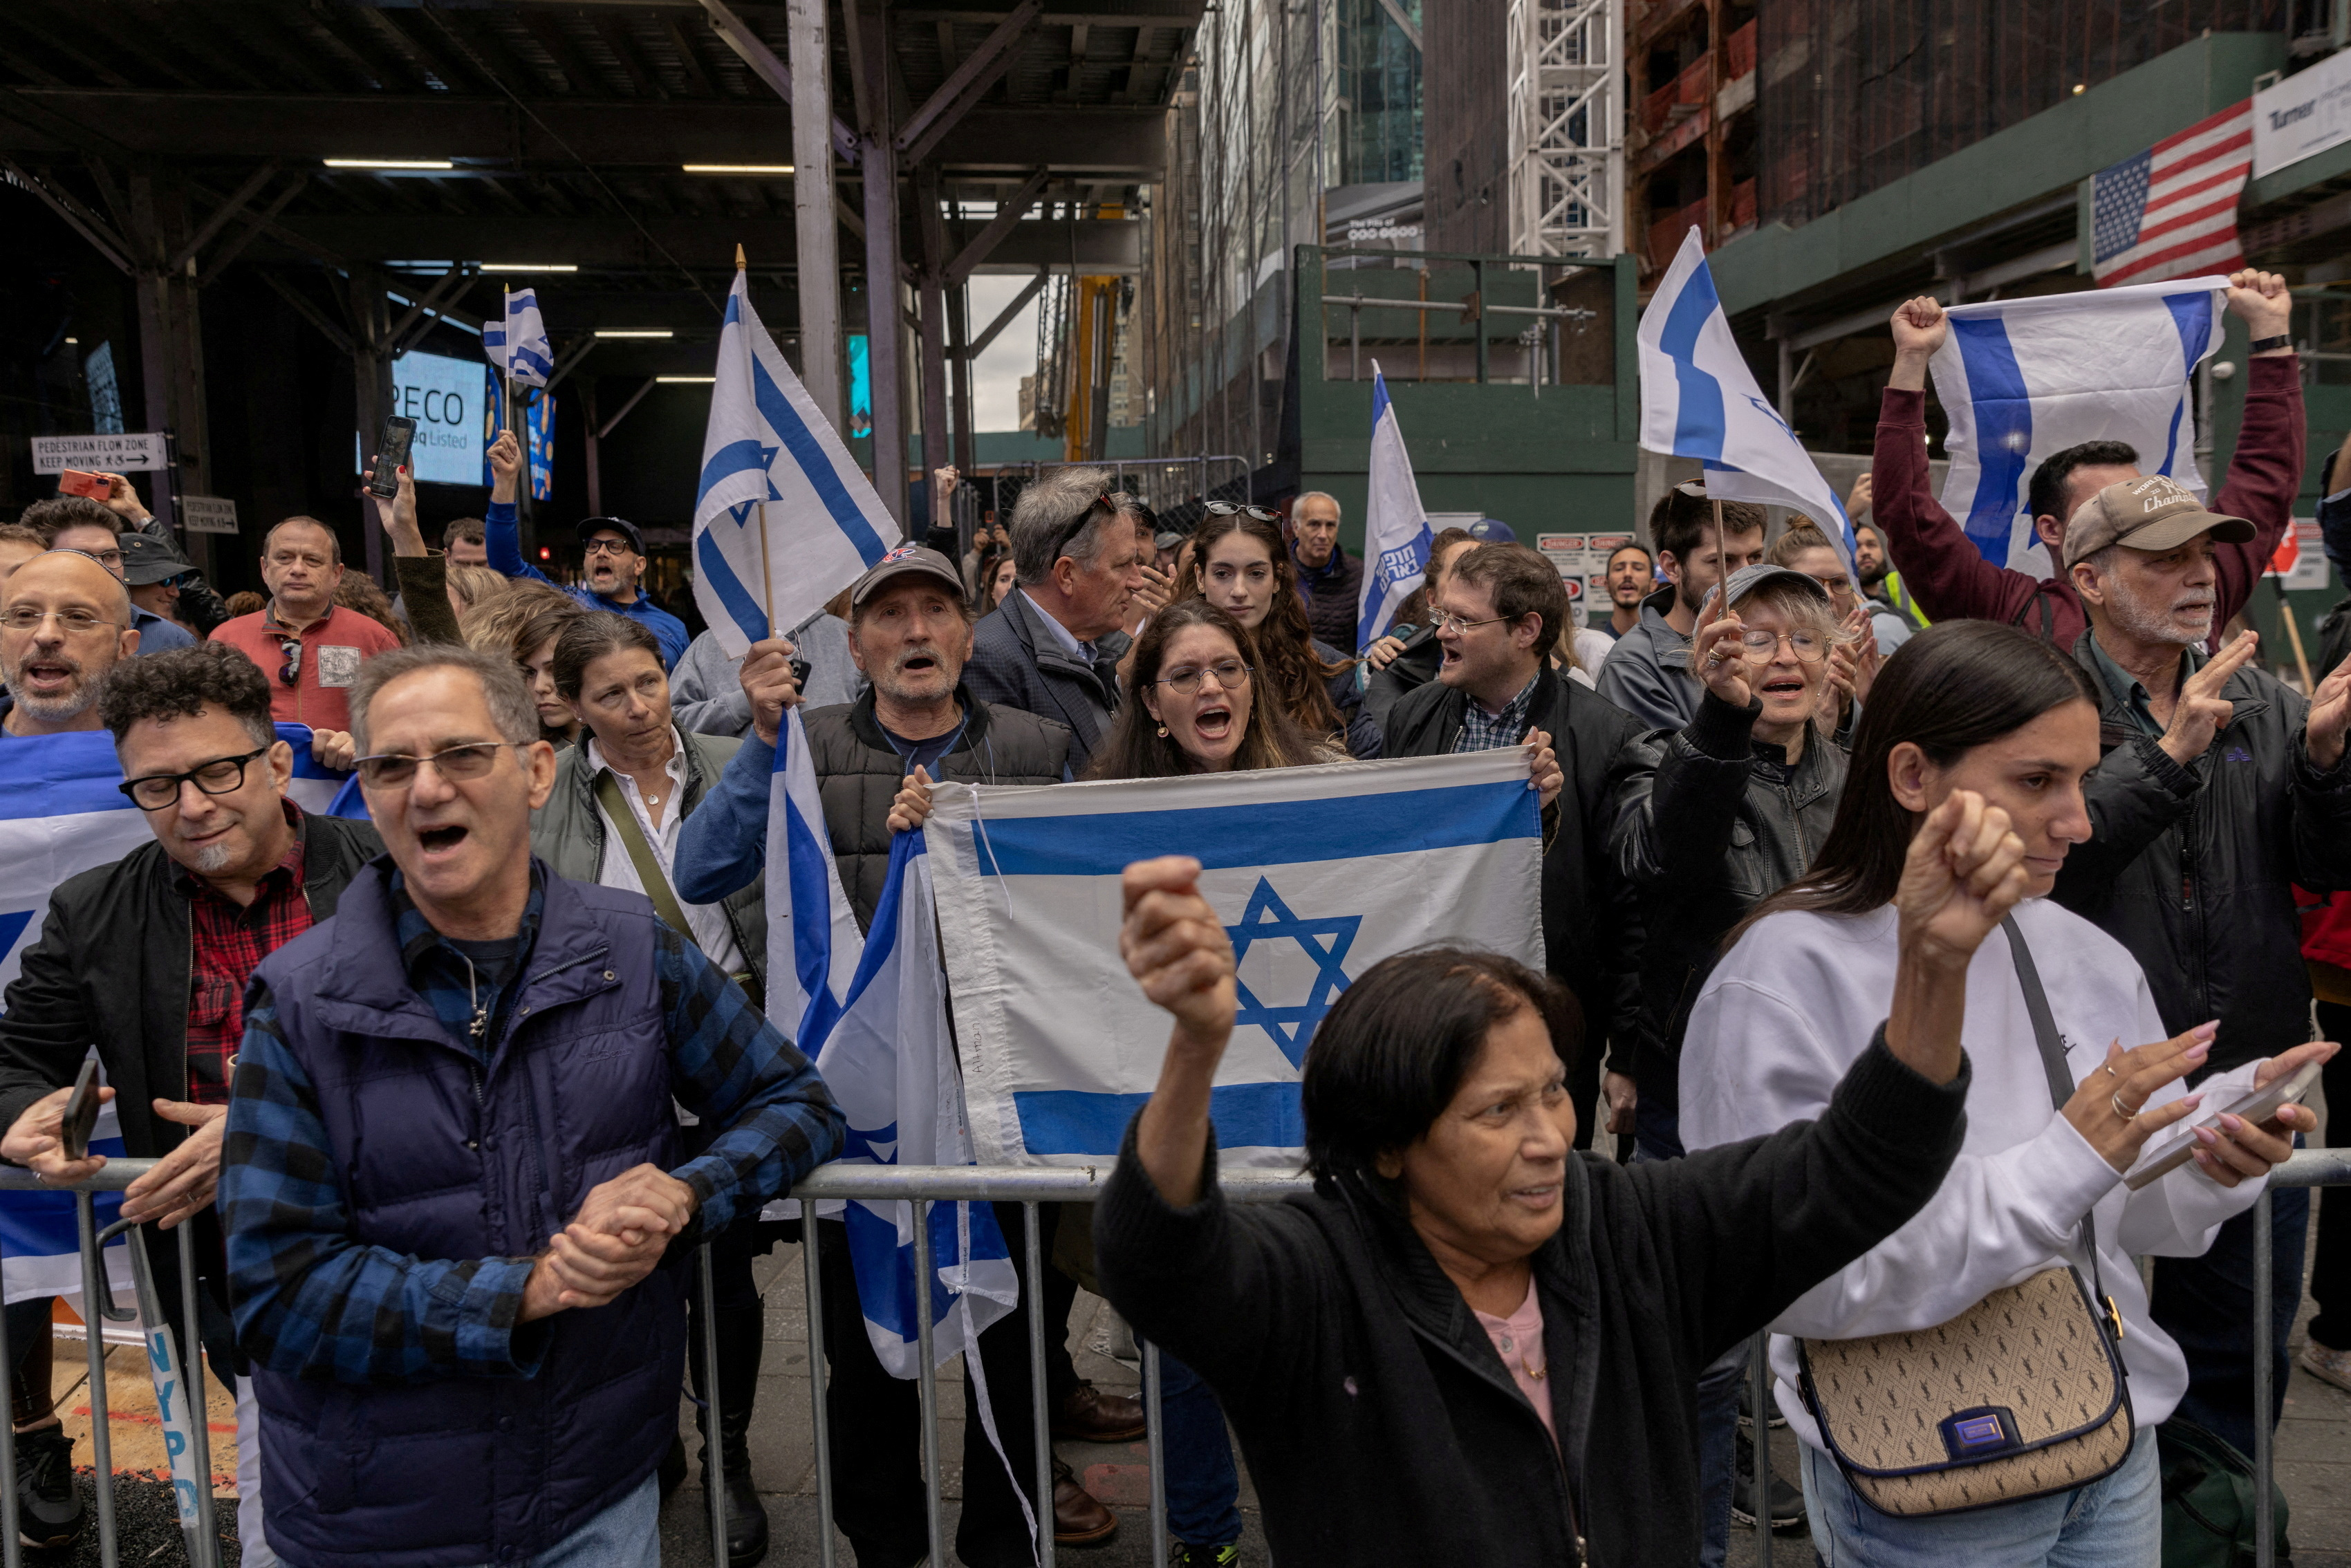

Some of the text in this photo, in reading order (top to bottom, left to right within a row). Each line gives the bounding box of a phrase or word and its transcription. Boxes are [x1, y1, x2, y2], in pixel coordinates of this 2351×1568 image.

[2269, 99, 2317, 131] Turner
[38, 439, 149, 454] PEDESTRIAN FLOW ZONE
[429, 429, 467, 449] Listed
[39, 456, 102, 468] KEEP MOVING
[2132, 476, 2163, 495] WORLD
[972, 1023, 984, 1073] Altman
[145, 1332, 198, 1518] NYPD
